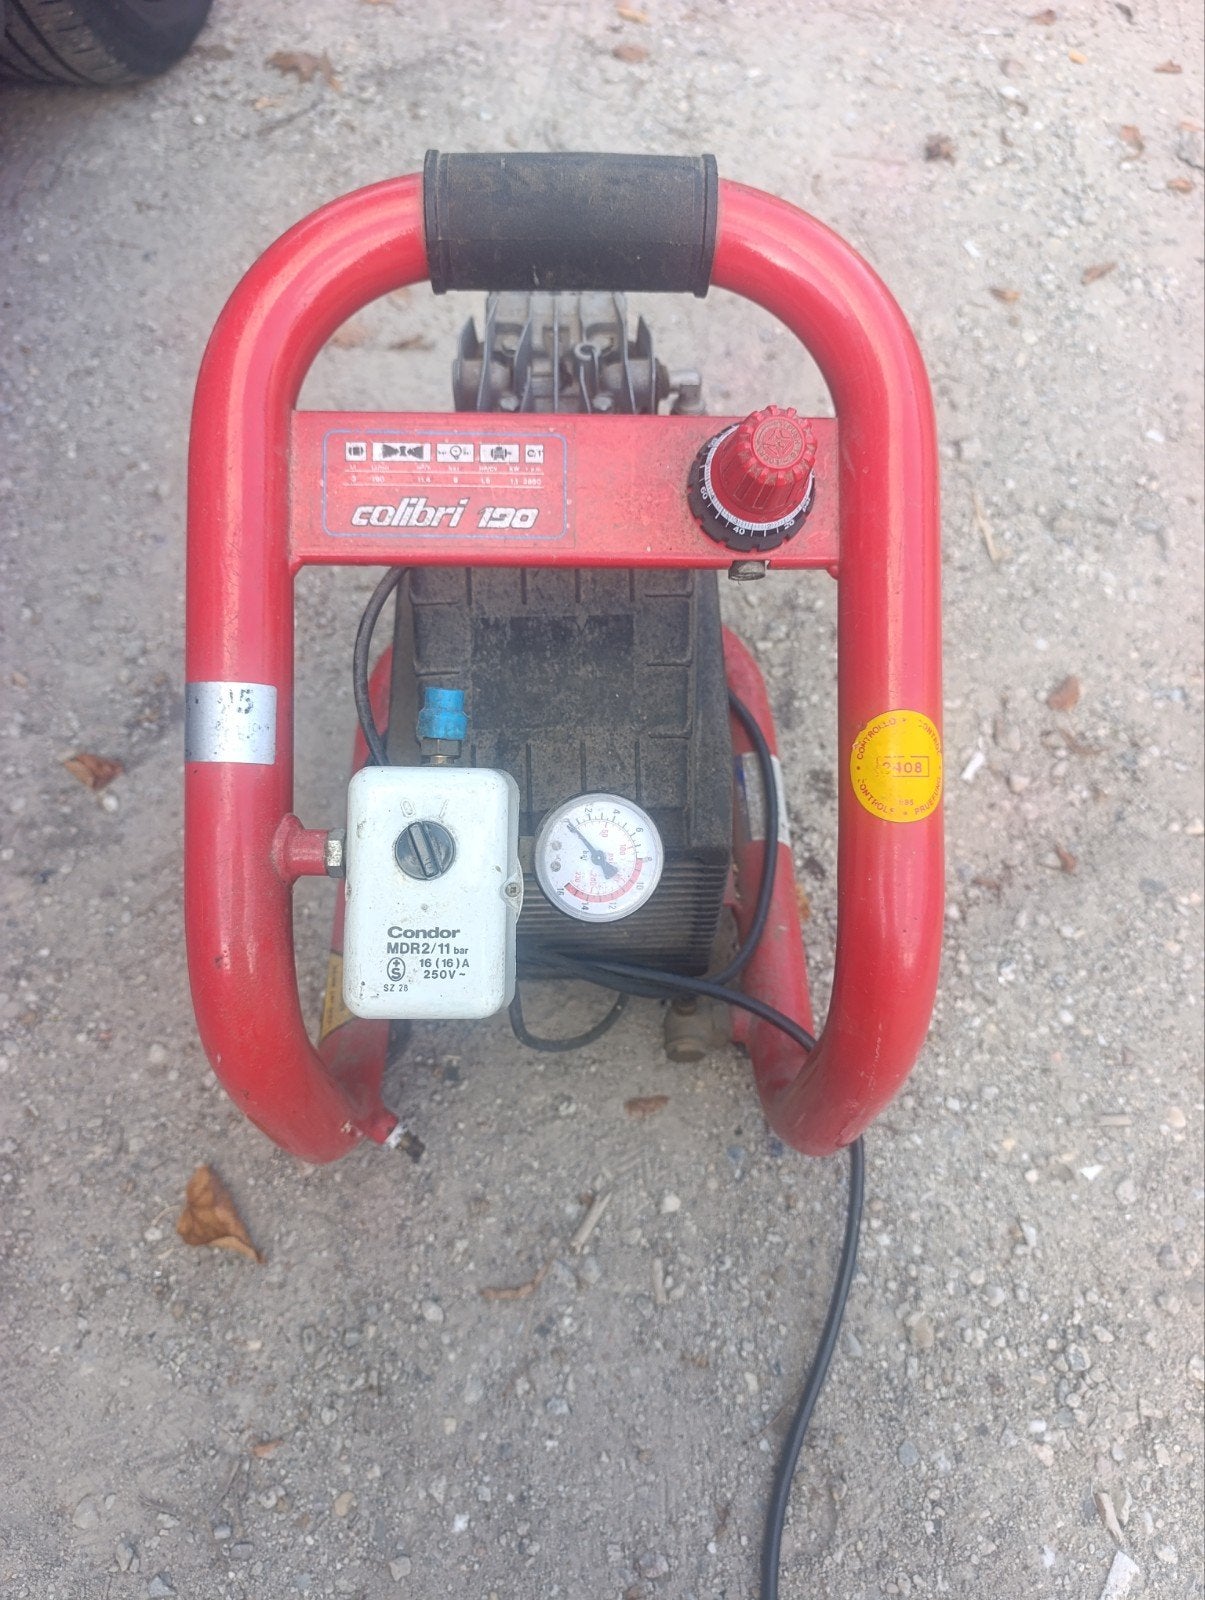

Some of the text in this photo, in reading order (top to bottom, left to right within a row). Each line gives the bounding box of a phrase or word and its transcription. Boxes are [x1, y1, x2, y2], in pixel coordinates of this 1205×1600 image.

[351, 496, 540, 530] colibri 190
[733, 526, 746, 536] 40
[387, 926, 461, 939] Condor
[386, 942, 469, 955] MDR2/11 bar
